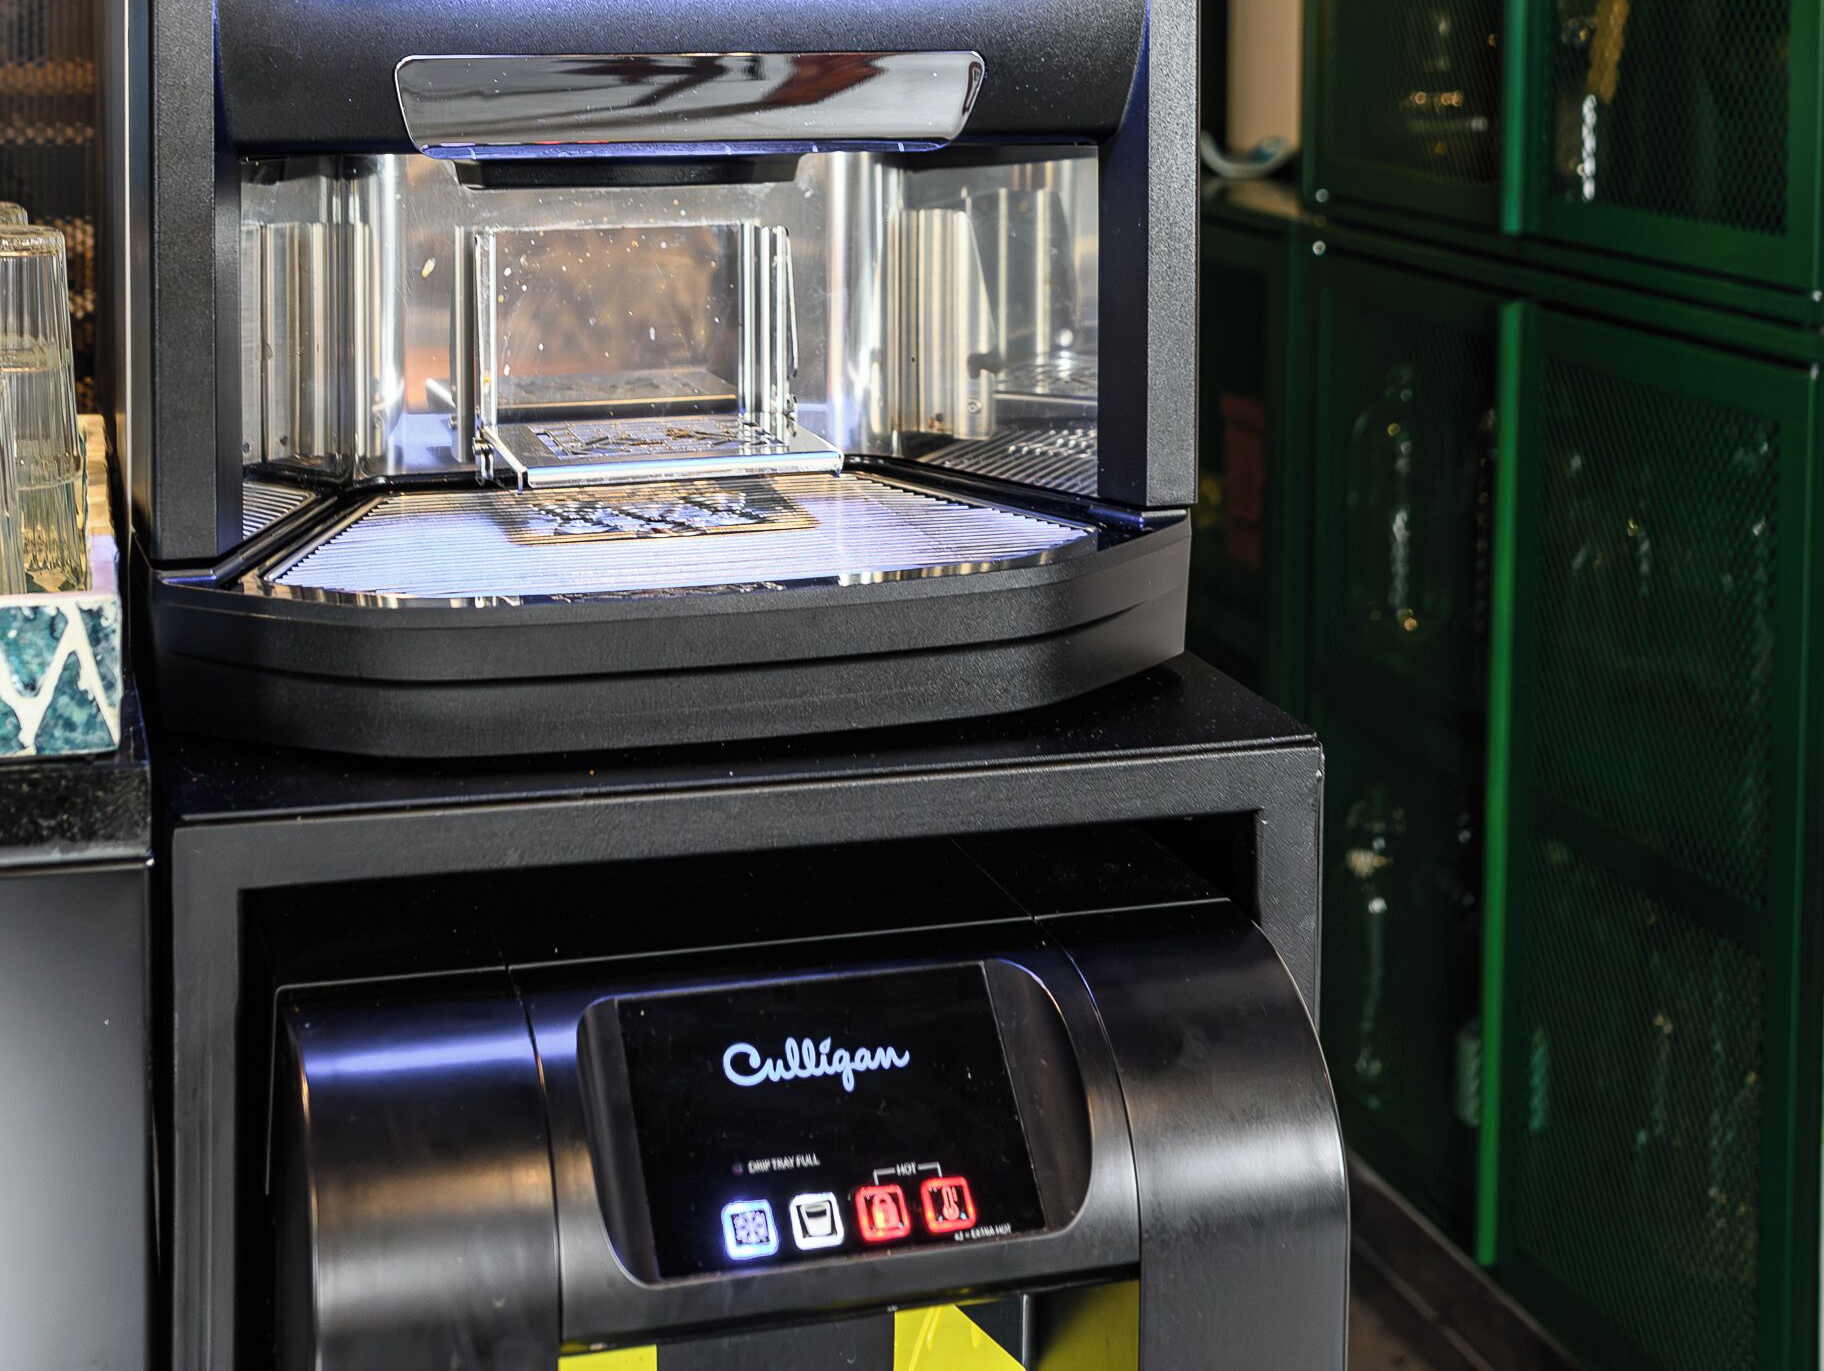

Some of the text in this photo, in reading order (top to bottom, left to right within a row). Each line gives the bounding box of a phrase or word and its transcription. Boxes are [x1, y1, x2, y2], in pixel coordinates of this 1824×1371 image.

[722, 1036, 911, 1093] Culligan
[747, 1152, 821, 1175] DRIP TRAY FULL
[896, 1161, 917, 1176] HOT
